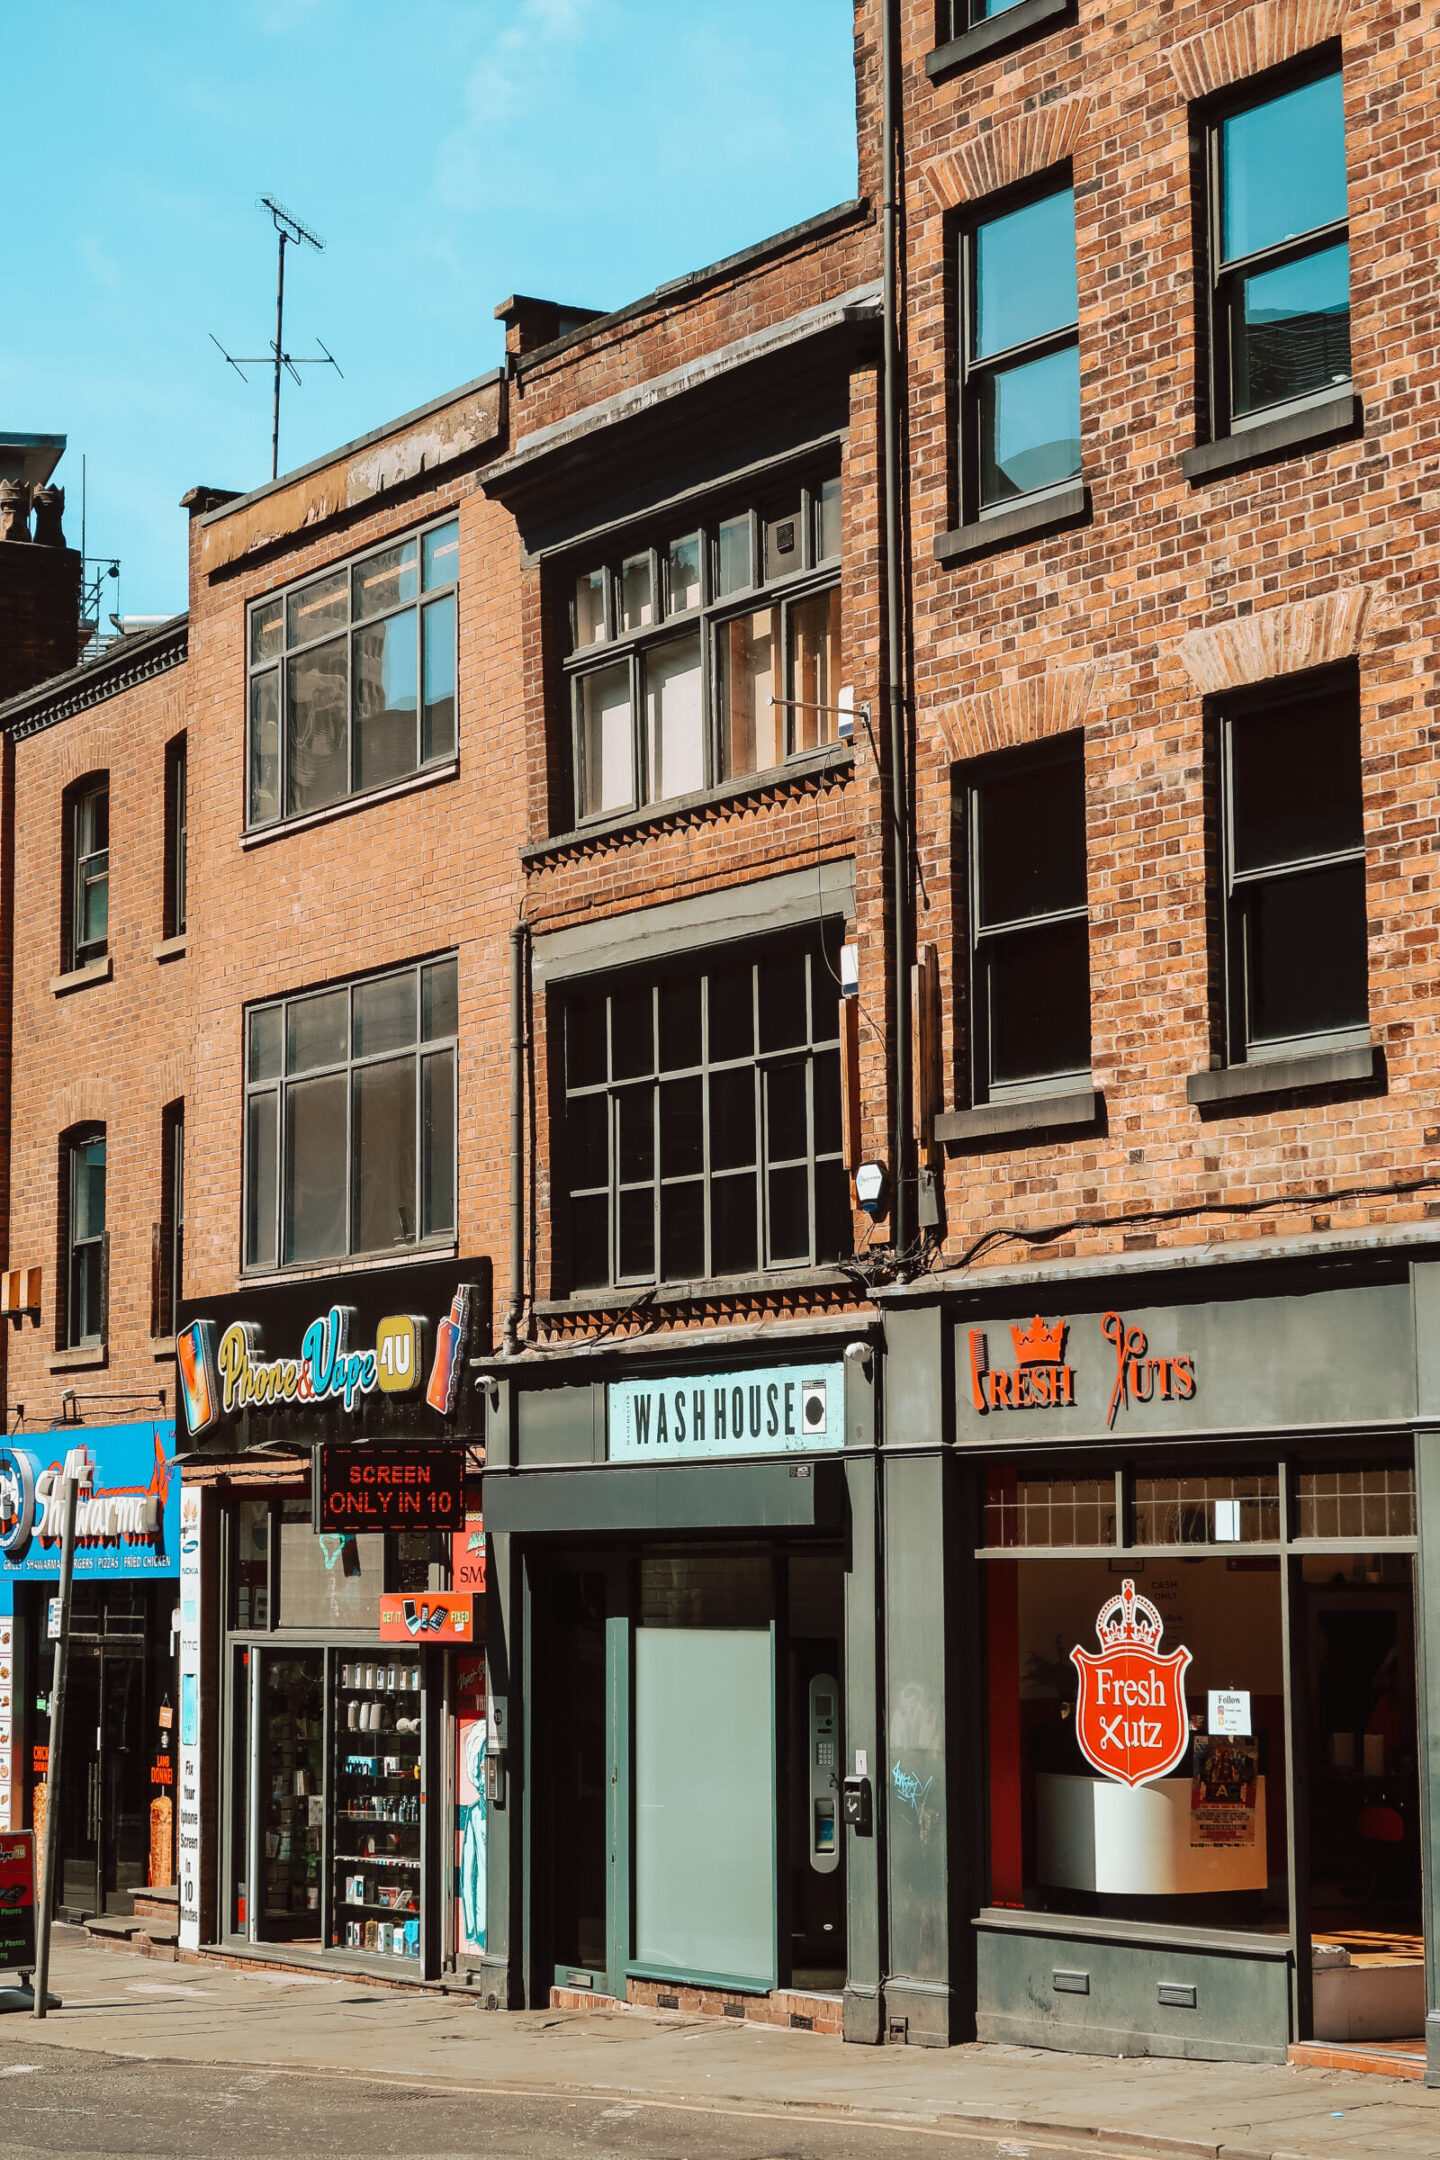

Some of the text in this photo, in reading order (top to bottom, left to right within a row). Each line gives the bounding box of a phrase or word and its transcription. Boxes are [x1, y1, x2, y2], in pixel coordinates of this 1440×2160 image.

[379, 1334, 411, 1376] 4U
[349, 1465, 431, 1485] SCREEN
[329, 1491, 452, 1513] ONLY IN 10
[124, 1555, 142, 1568] FRIED
[143, 1555, 171, 1567] CHICKEN
[460, 1567, 486, 1584] SM
[1095, 1668, 1167, 1707] Fresh
[185, 1760, 194, 1776] Fix
[181, 1833, 198, 1849] Screen
[185, 1880, 194, 1903] 10
